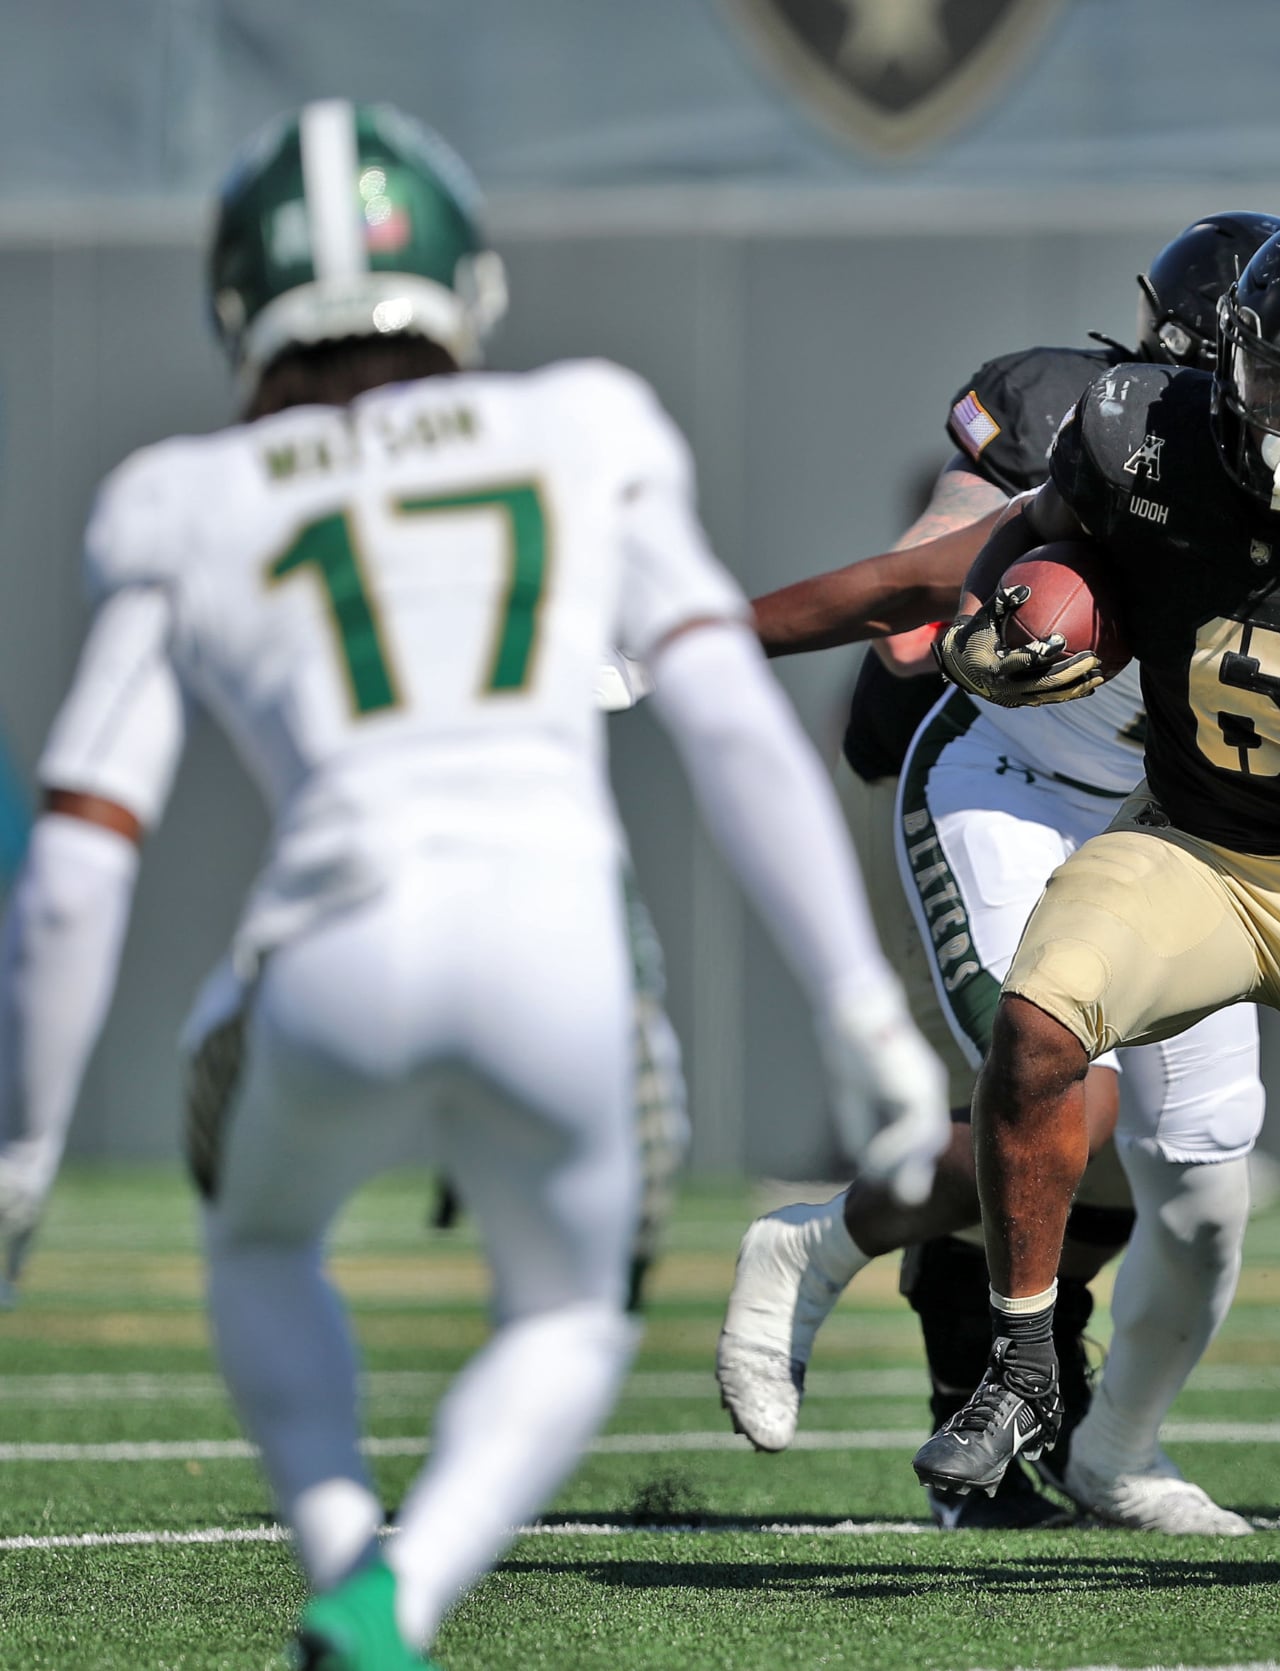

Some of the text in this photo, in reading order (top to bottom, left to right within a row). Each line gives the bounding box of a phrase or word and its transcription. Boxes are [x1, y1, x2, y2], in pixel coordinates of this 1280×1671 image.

[262, 477, 555, 720] 17
[1129, 495, 1170, 525] UDOH
[902, 807, 980, 991] BLAZERS
